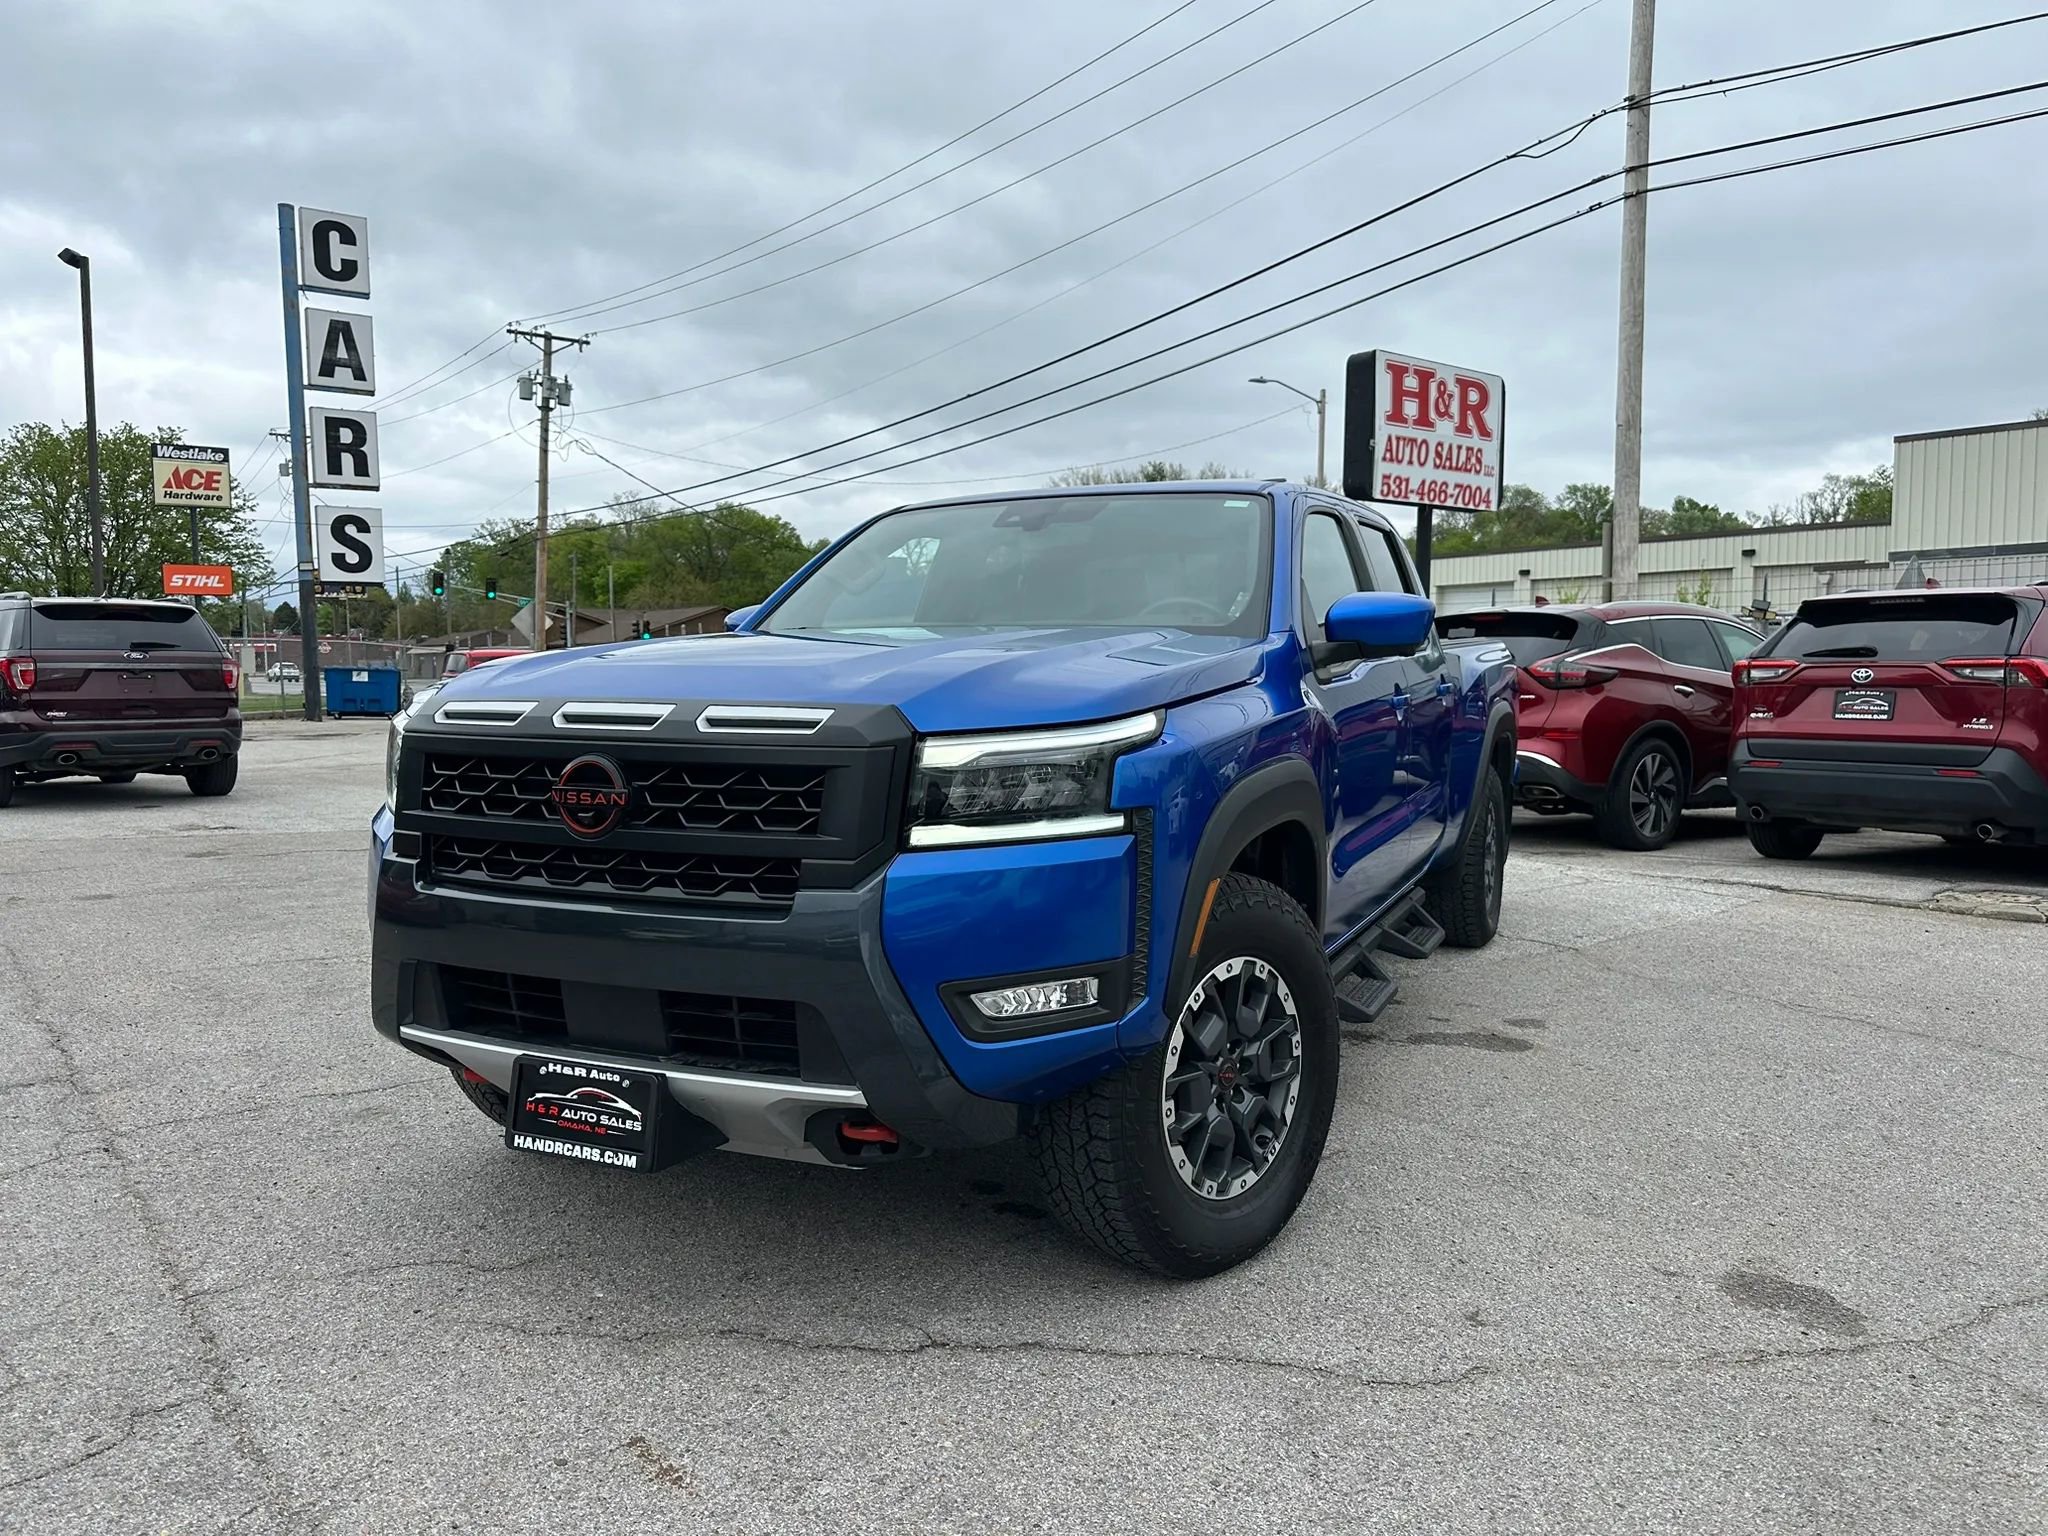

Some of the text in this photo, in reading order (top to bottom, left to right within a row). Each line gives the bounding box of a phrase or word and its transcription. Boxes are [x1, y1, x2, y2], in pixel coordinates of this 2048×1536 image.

[1384, 359, 1493, 441] H&R
[156, 445, 224, 462] Westlake
[1382, 434, 1429, 467] AUTO
[1433, 441, 1483, 475] SALES
[162, 465, 222, 492] ACE
[163, 490, 223, 502] Hardware
[1380, 473, 1492, 509] 531-466-7004
[170, 575, 224, 587] STIHL
[551, 790, 626, 805] NISSAN
[548, 1062, 620, 1082] H&R Auto
[526, 1102, 535, 1112] H
[549, 1106, 559, 1116] R
[561, 1108, 598, 1123] AUTO
[600, 1114, 643, 1132] SALES
[594, 1126, 607, 1135] NE
[514, 1134, 638, 1169] HANDRCARS.COM
